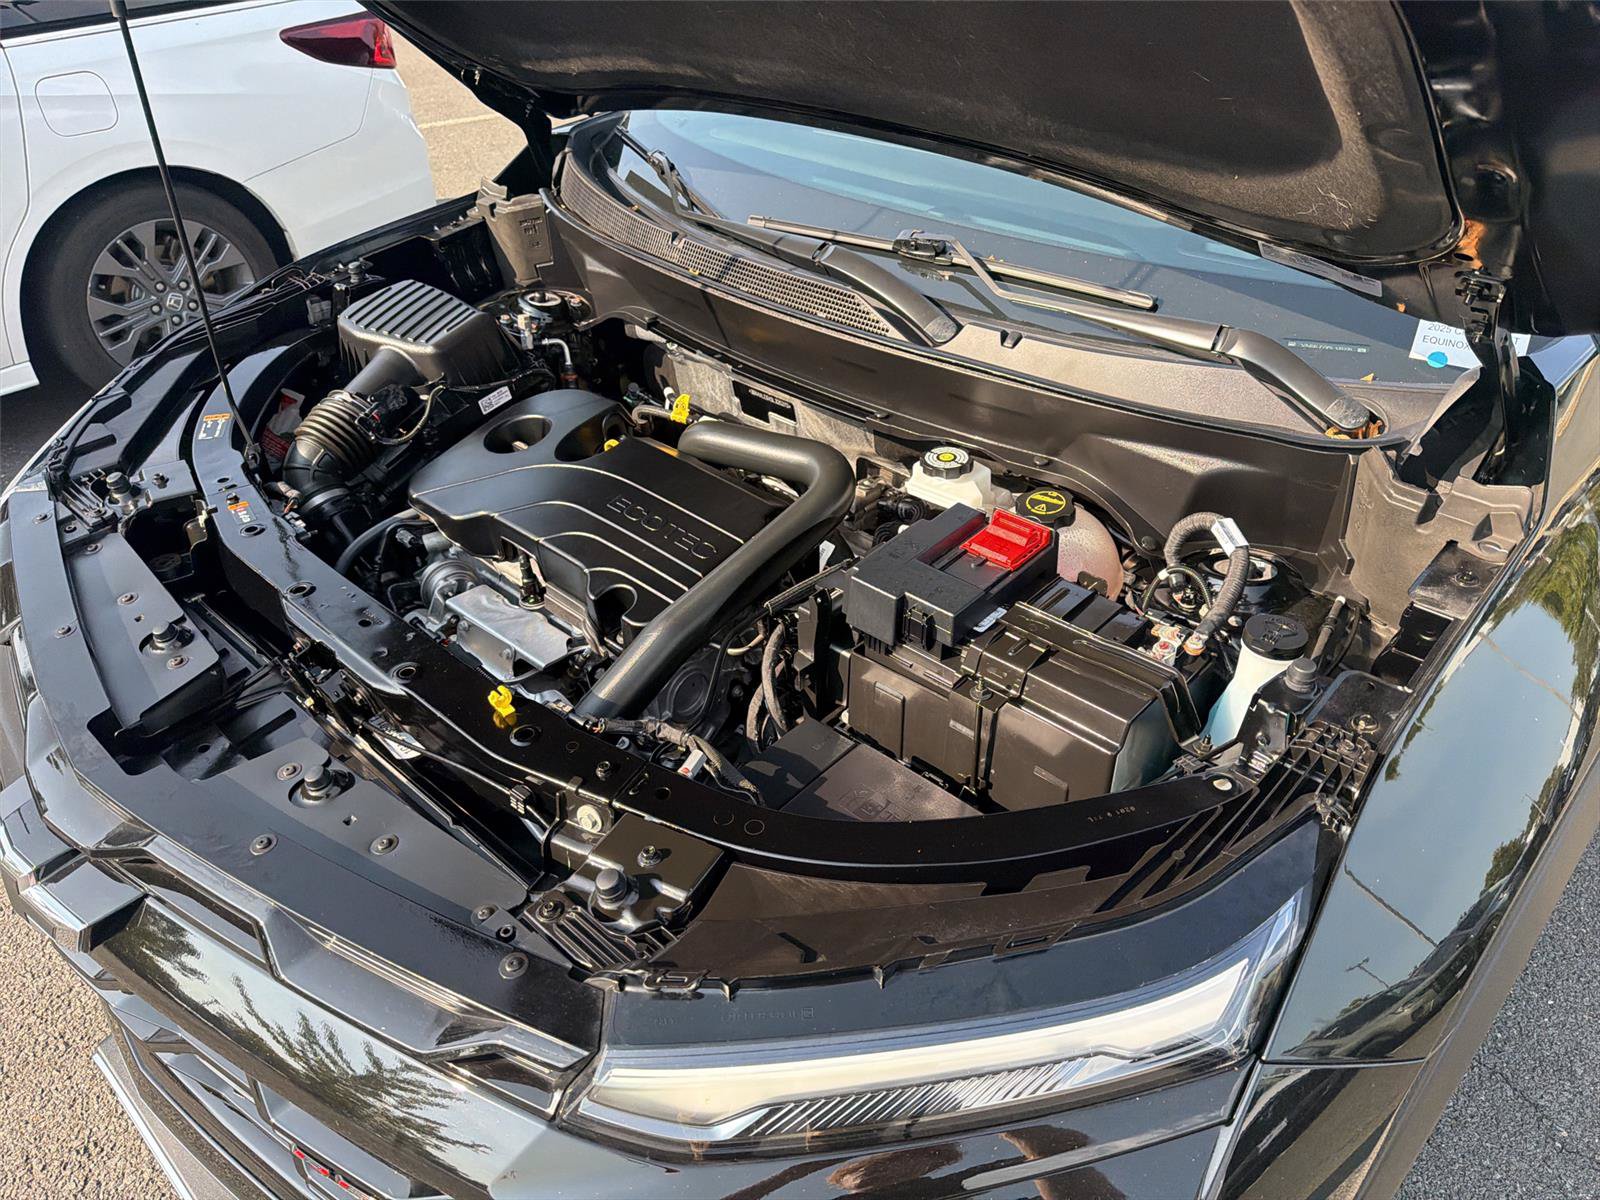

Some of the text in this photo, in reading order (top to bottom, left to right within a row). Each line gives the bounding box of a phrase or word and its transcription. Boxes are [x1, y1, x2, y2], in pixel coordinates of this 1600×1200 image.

[1428, 323, 1452, 334] 2025
[1422, 335, 1470, 351] EQUINOX
[606, 496, 718, 560] ECOTEC
